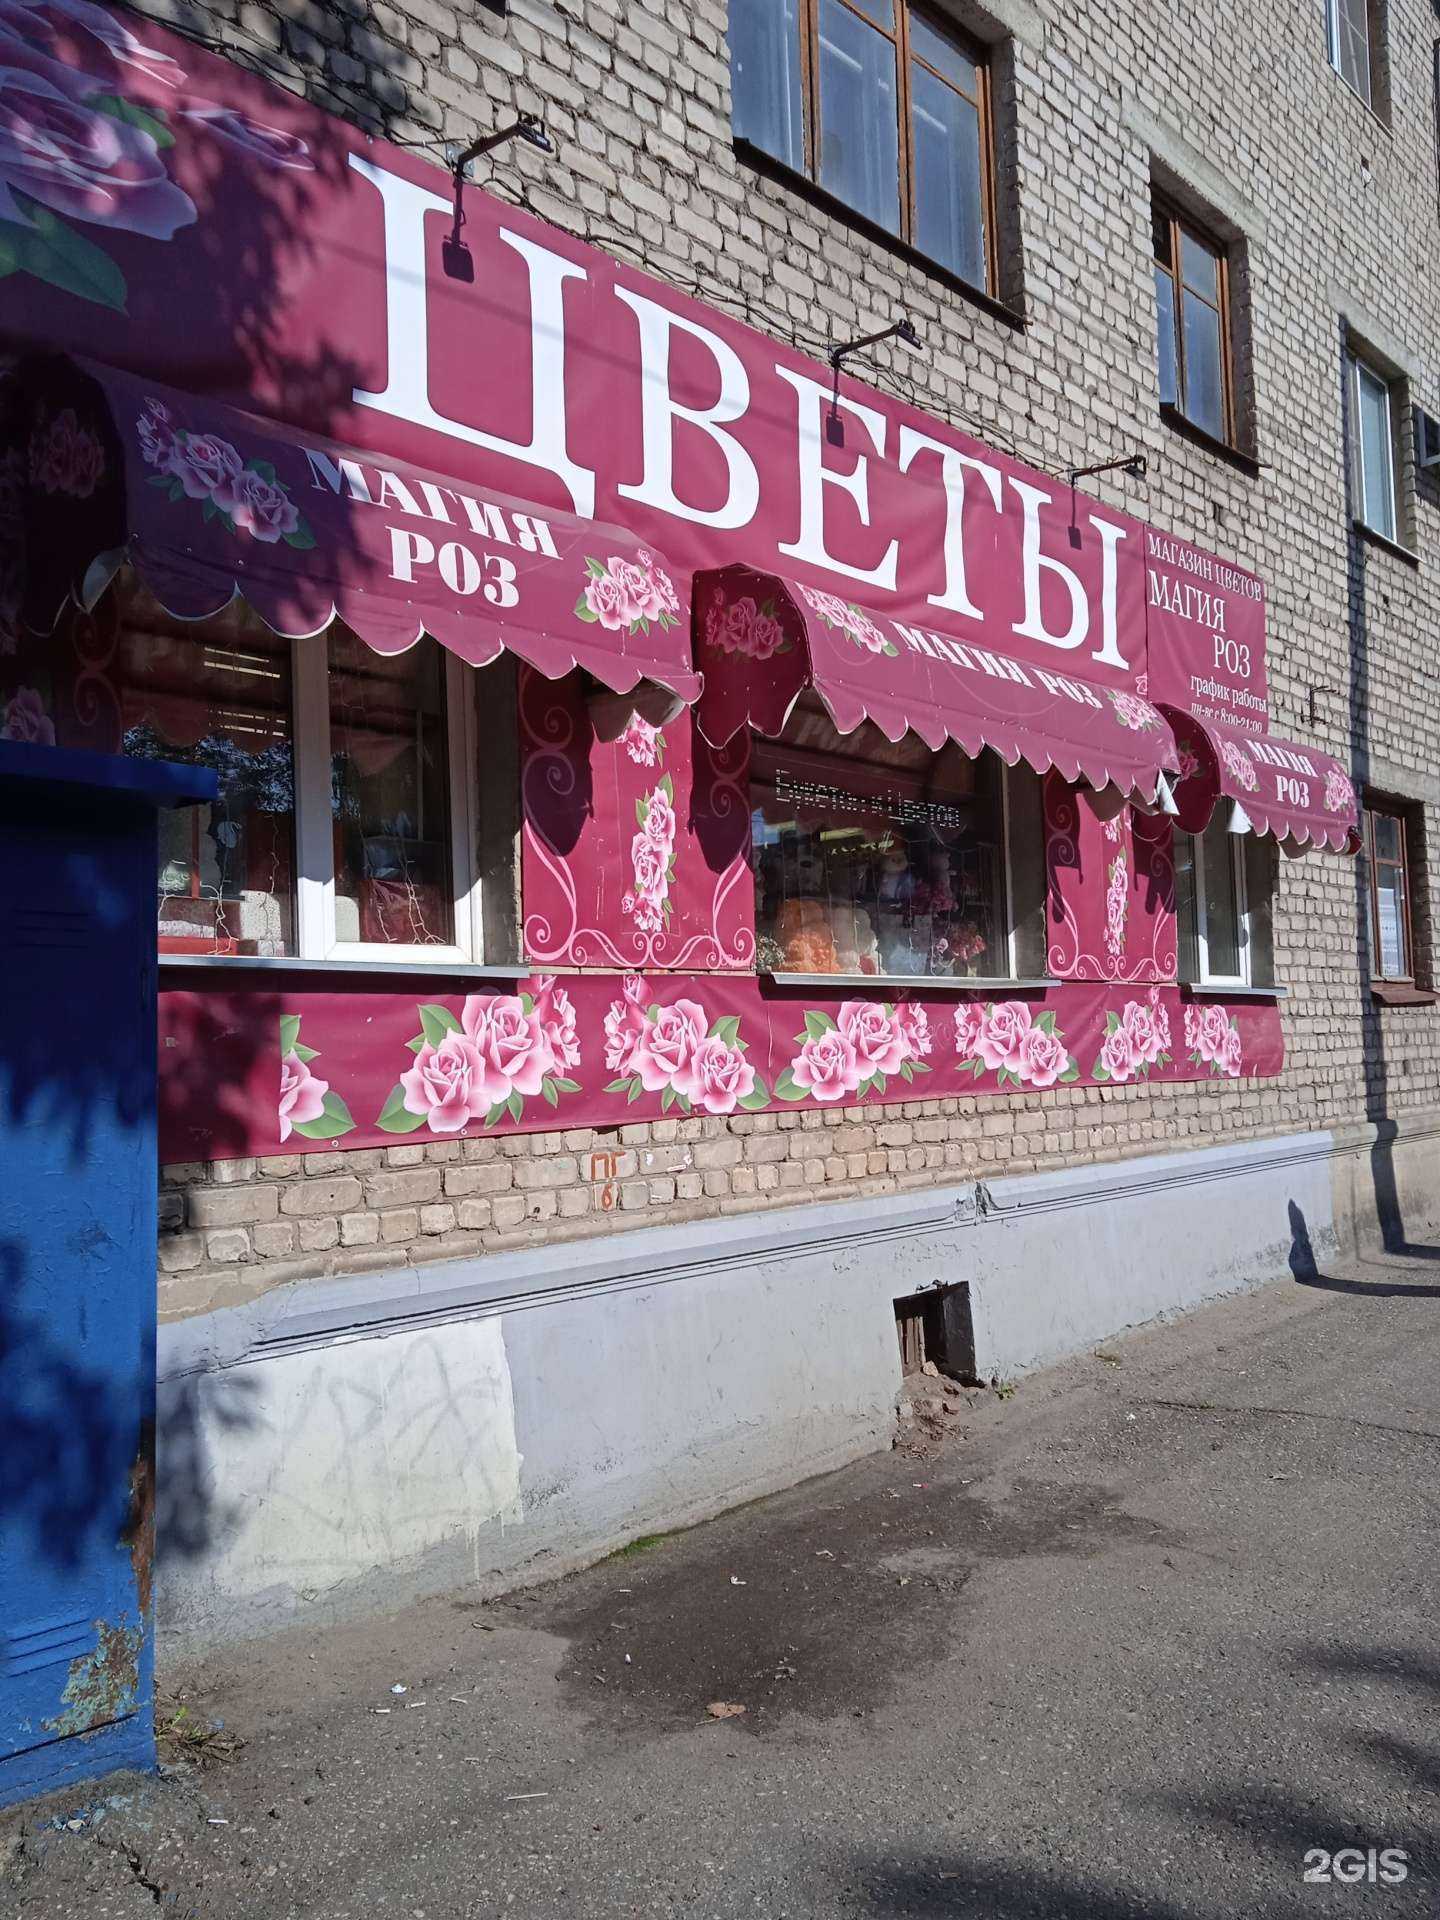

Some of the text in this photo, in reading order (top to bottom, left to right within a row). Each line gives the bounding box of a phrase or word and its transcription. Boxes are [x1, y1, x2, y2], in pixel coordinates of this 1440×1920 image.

[348, 152, 1130, 670] ЦВЕТЫ
[296, 444, 564, 561] МАГИЯ
[384, 525, 520, 609] РОЗ
[1148, 533, 1262, 602] МАГАЗИН ЦВЕТОВ
[1148, 568, 1226, 633] МАГИЯ
[888, 619, 1104, 710] МАГИЯ РОЗ
[1212, 633, 1251, 678] РОЗ
[1190, 675, 1267, 713] график работы
[1243, 738, 1319, 778] МАГИЯ
[1275, 774, 1310, 808] РОЗ
[591, 1151, 626, 1182] ПГ
